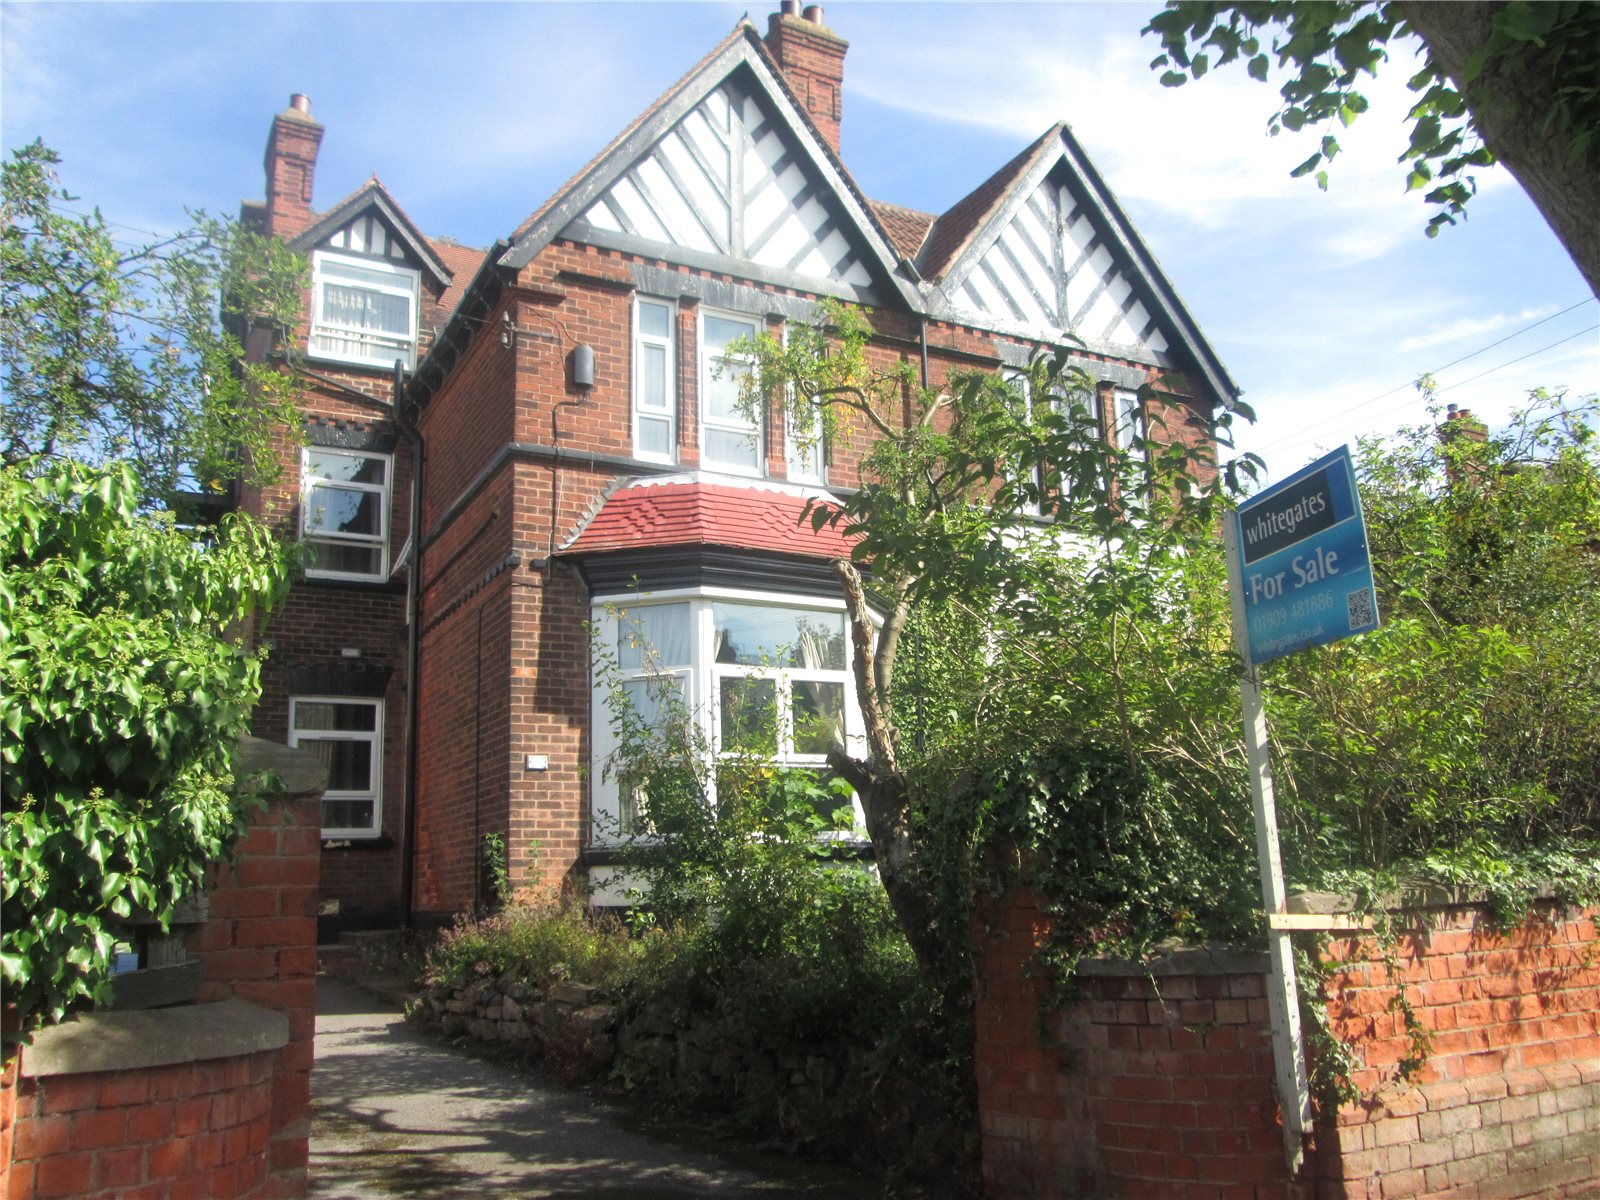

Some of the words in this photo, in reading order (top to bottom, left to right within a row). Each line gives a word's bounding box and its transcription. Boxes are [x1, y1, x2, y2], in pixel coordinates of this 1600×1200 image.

[1246, 492, 1326, 545] whitegates
[1249, 571, 1286, 605] For
[1291, 546, 1340, 589] Sale
[1254, 607, 1287, 633] 01909
